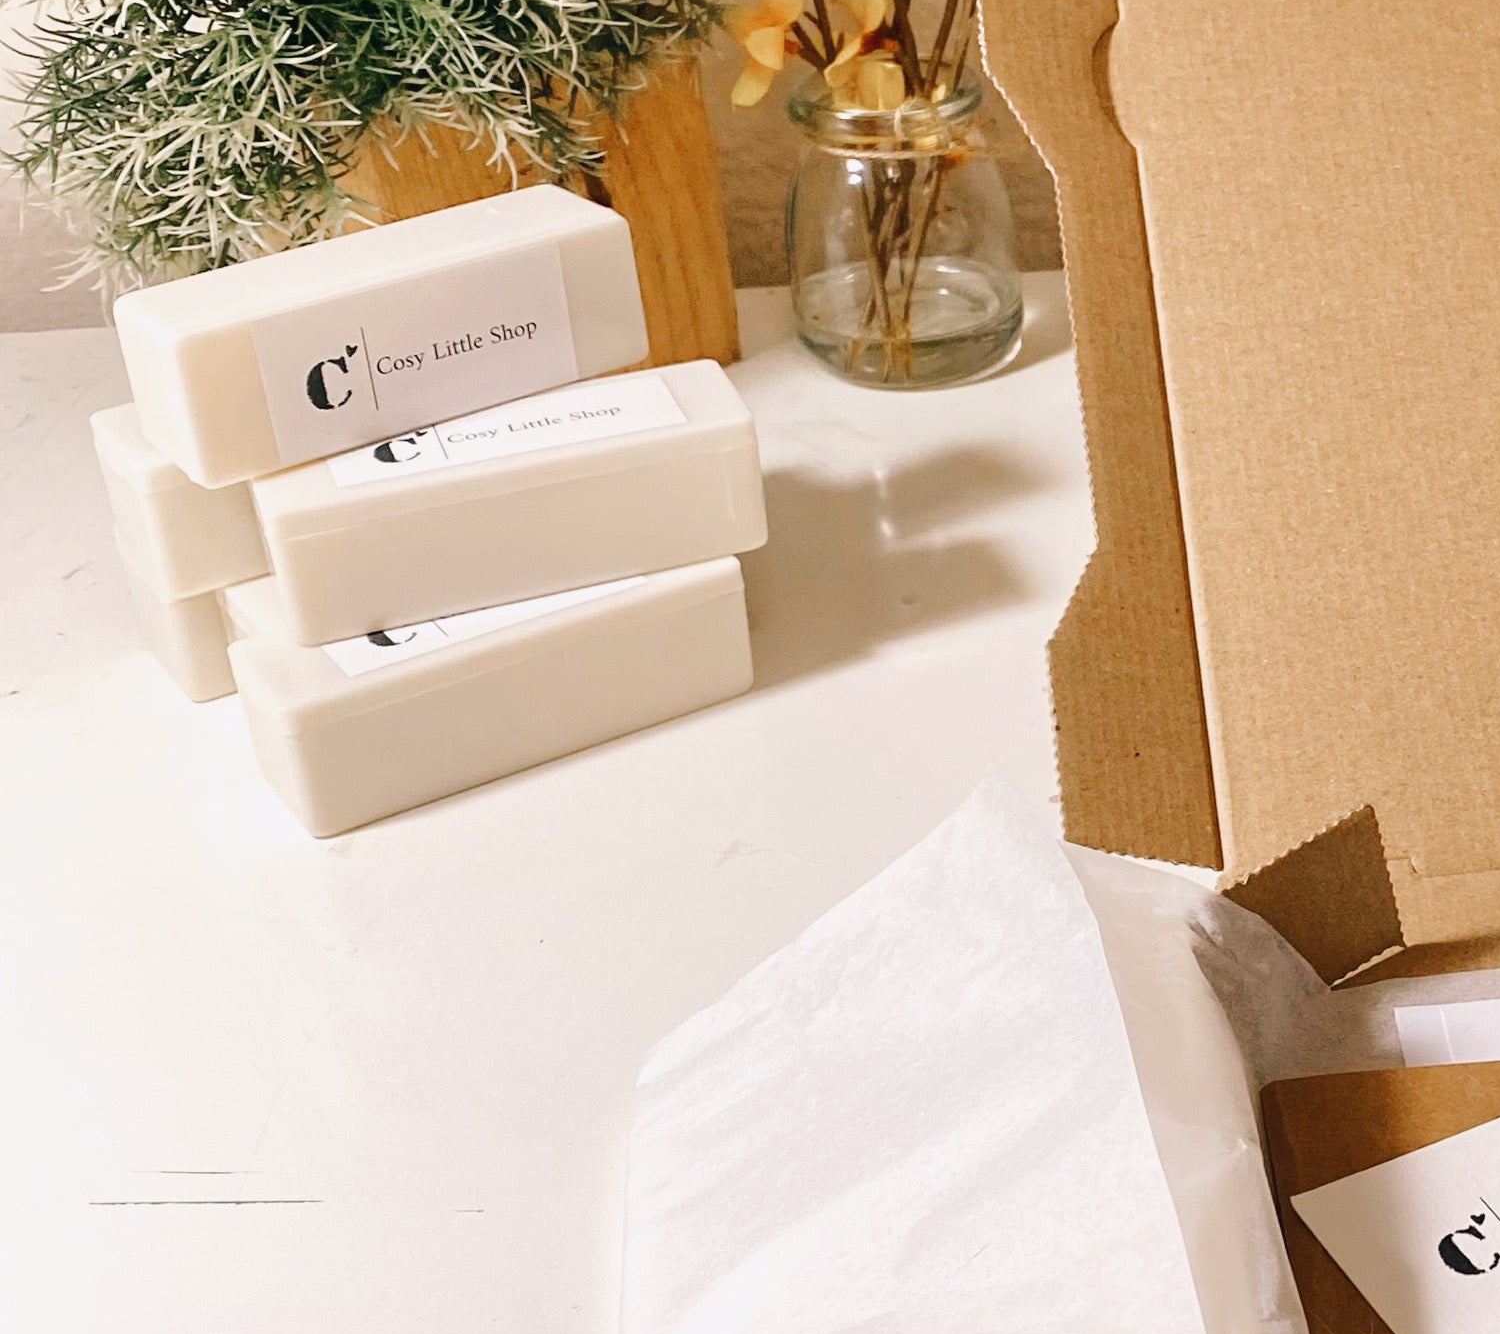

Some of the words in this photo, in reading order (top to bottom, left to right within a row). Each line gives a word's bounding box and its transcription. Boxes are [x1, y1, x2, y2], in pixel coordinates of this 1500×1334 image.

[305, 356, 353, 410] C
[376, 351, 425, 375] Cosy
[432, 333, 484, 360] Little
[489, 320, 538, 345] Shop
[446, 427, 499, 444] Cosy
[507, 416, 563, 433] Little
[568, 405, 622, 422] Shop
[1438, 1225, 1500, 1276] C
